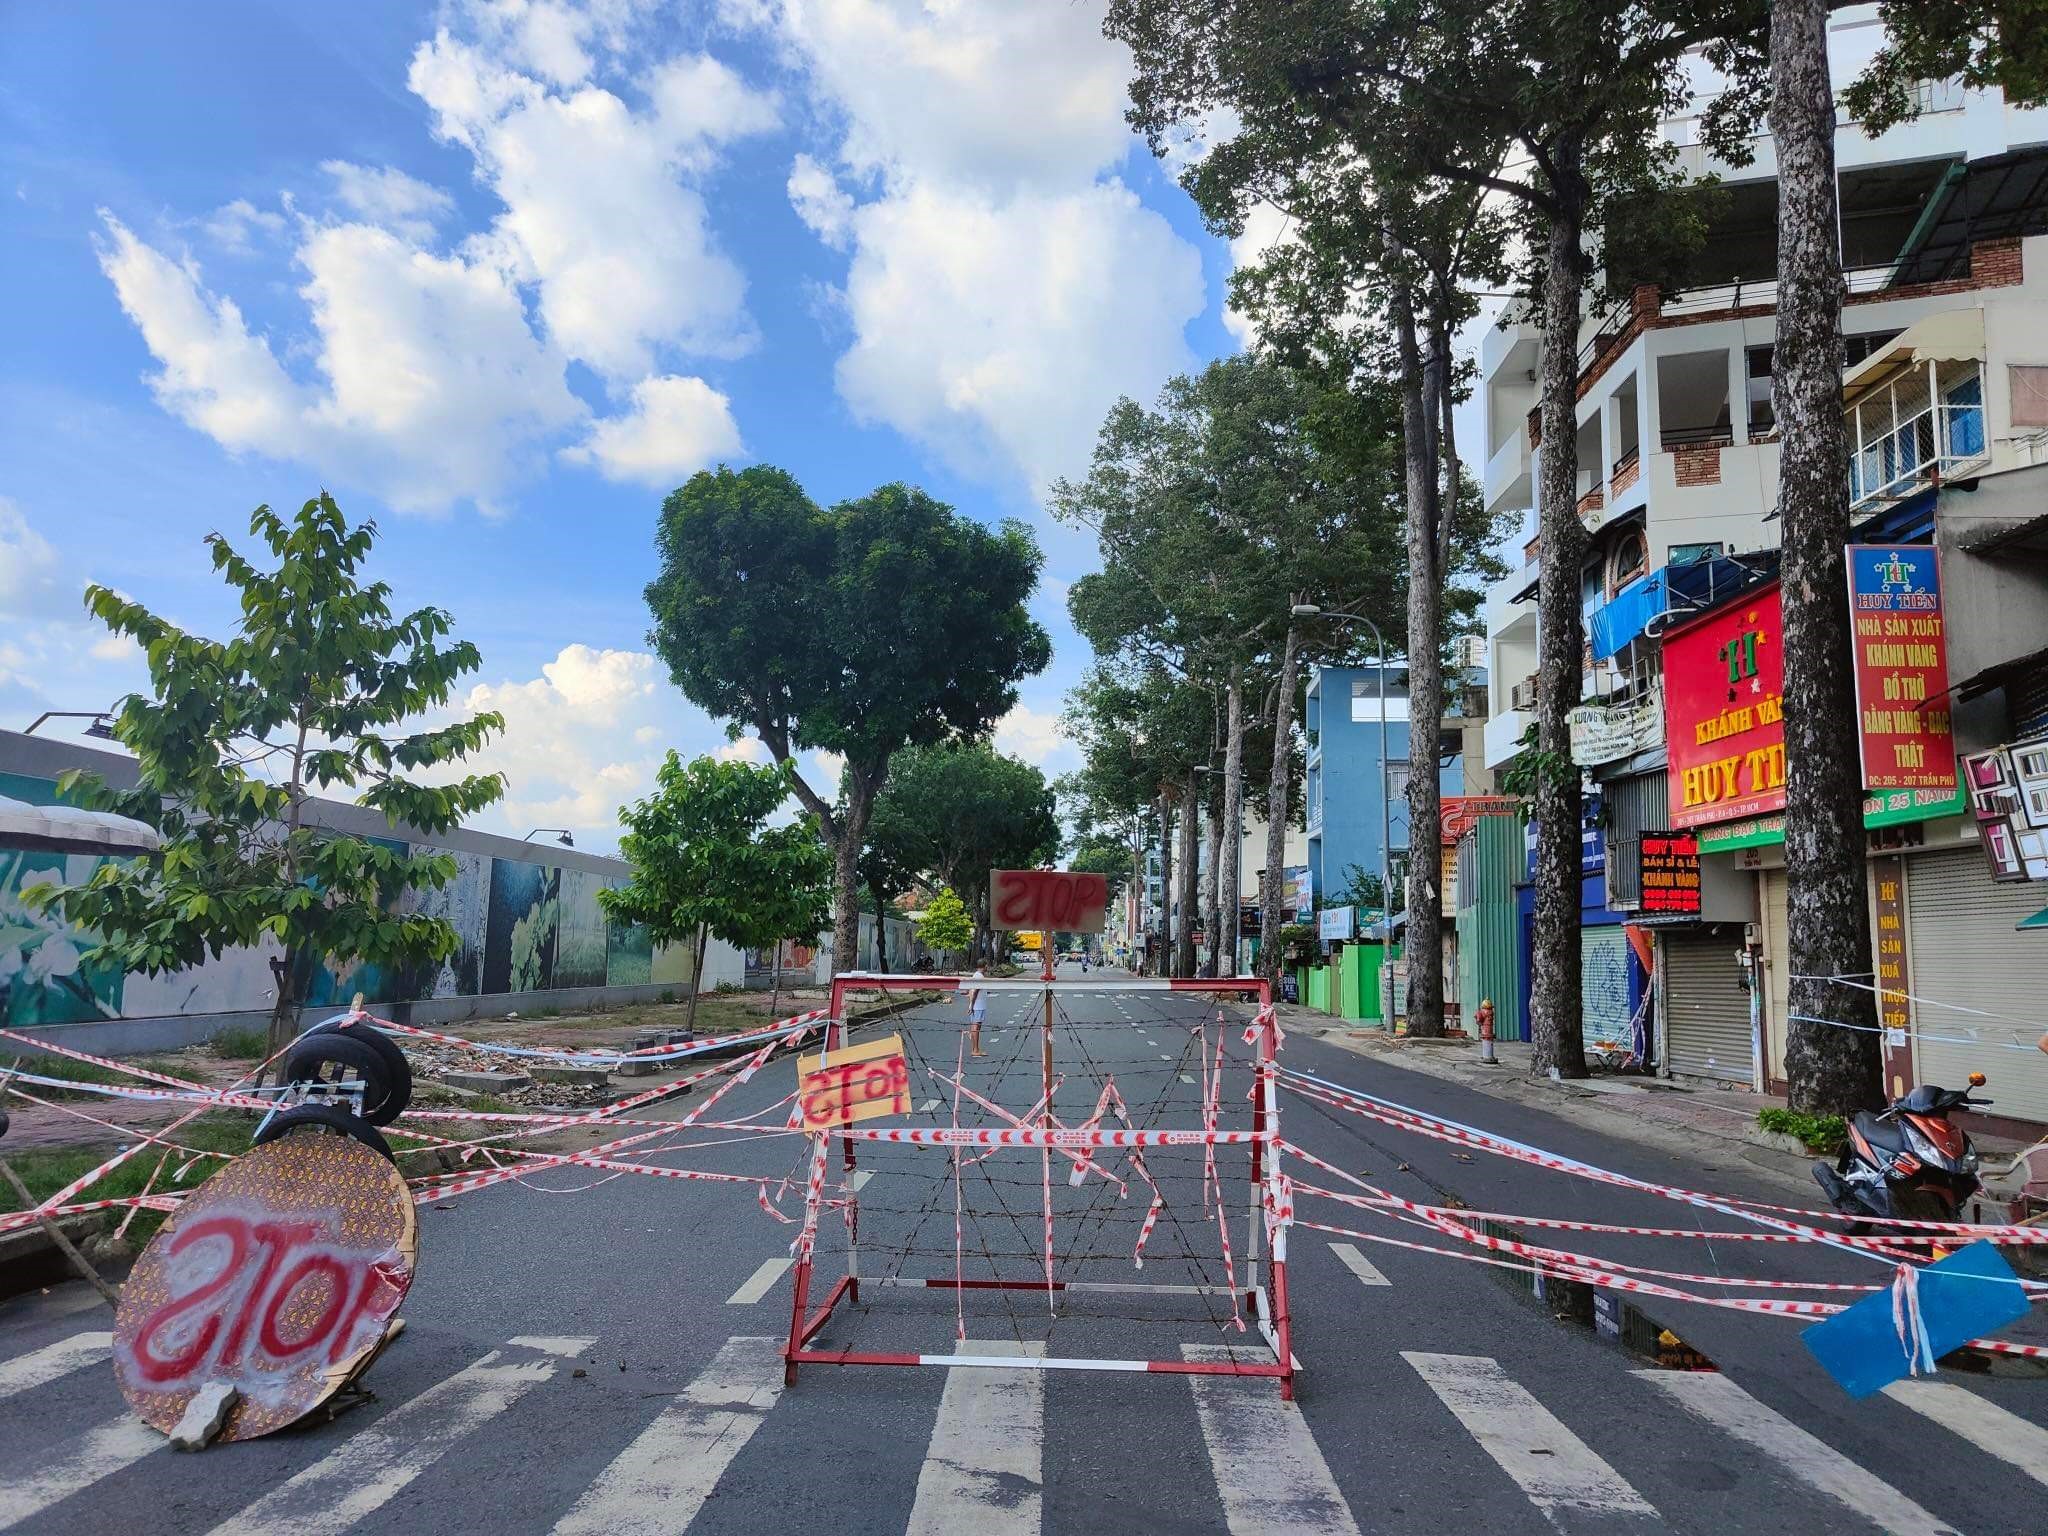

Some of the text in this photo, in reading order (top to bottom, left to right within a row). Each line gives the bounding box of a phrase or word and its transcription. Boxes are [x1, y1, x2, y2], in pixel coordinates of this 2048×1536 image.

[1857, 593, 1893, 609] HUY
[1857, 612, 1942, 636] NHÀ SẢN XUẤT
[1866, 639, 1938, 667] KHÁNH VÀNG
[1883, 671, 1926, 700] ĐỒ THỜ
[1695, 708, 1753, 745] KHÁNH
[1864, 704, 1950, 739] BẰNG VÀNG BẠC
[1893, 740, 1924, 772] THẬT
[1681, 743, 1785, 807] HUY TI
[1883, 776, 1897, 786] 205
[1903, 775, 1917, 786] 207
[1889, 792, 1909, 810] 25
[1643, 856, 1664, 868] BÁN
[1643, 869, 1698, 887] KHÁNH VÀNG
[998, 872, 1106, 927] STOP
[1880, 912, 1899, 929] NHÀ
[1881, 935, 1901, 954] SẢN
[1882, 987, 1907, 1006] TRỰC
[1884, 1009, 1907, 1027] TIẾP
[803, 1056, 908, 1125] STOP
[132, 1216, 411, 1383] STOP
